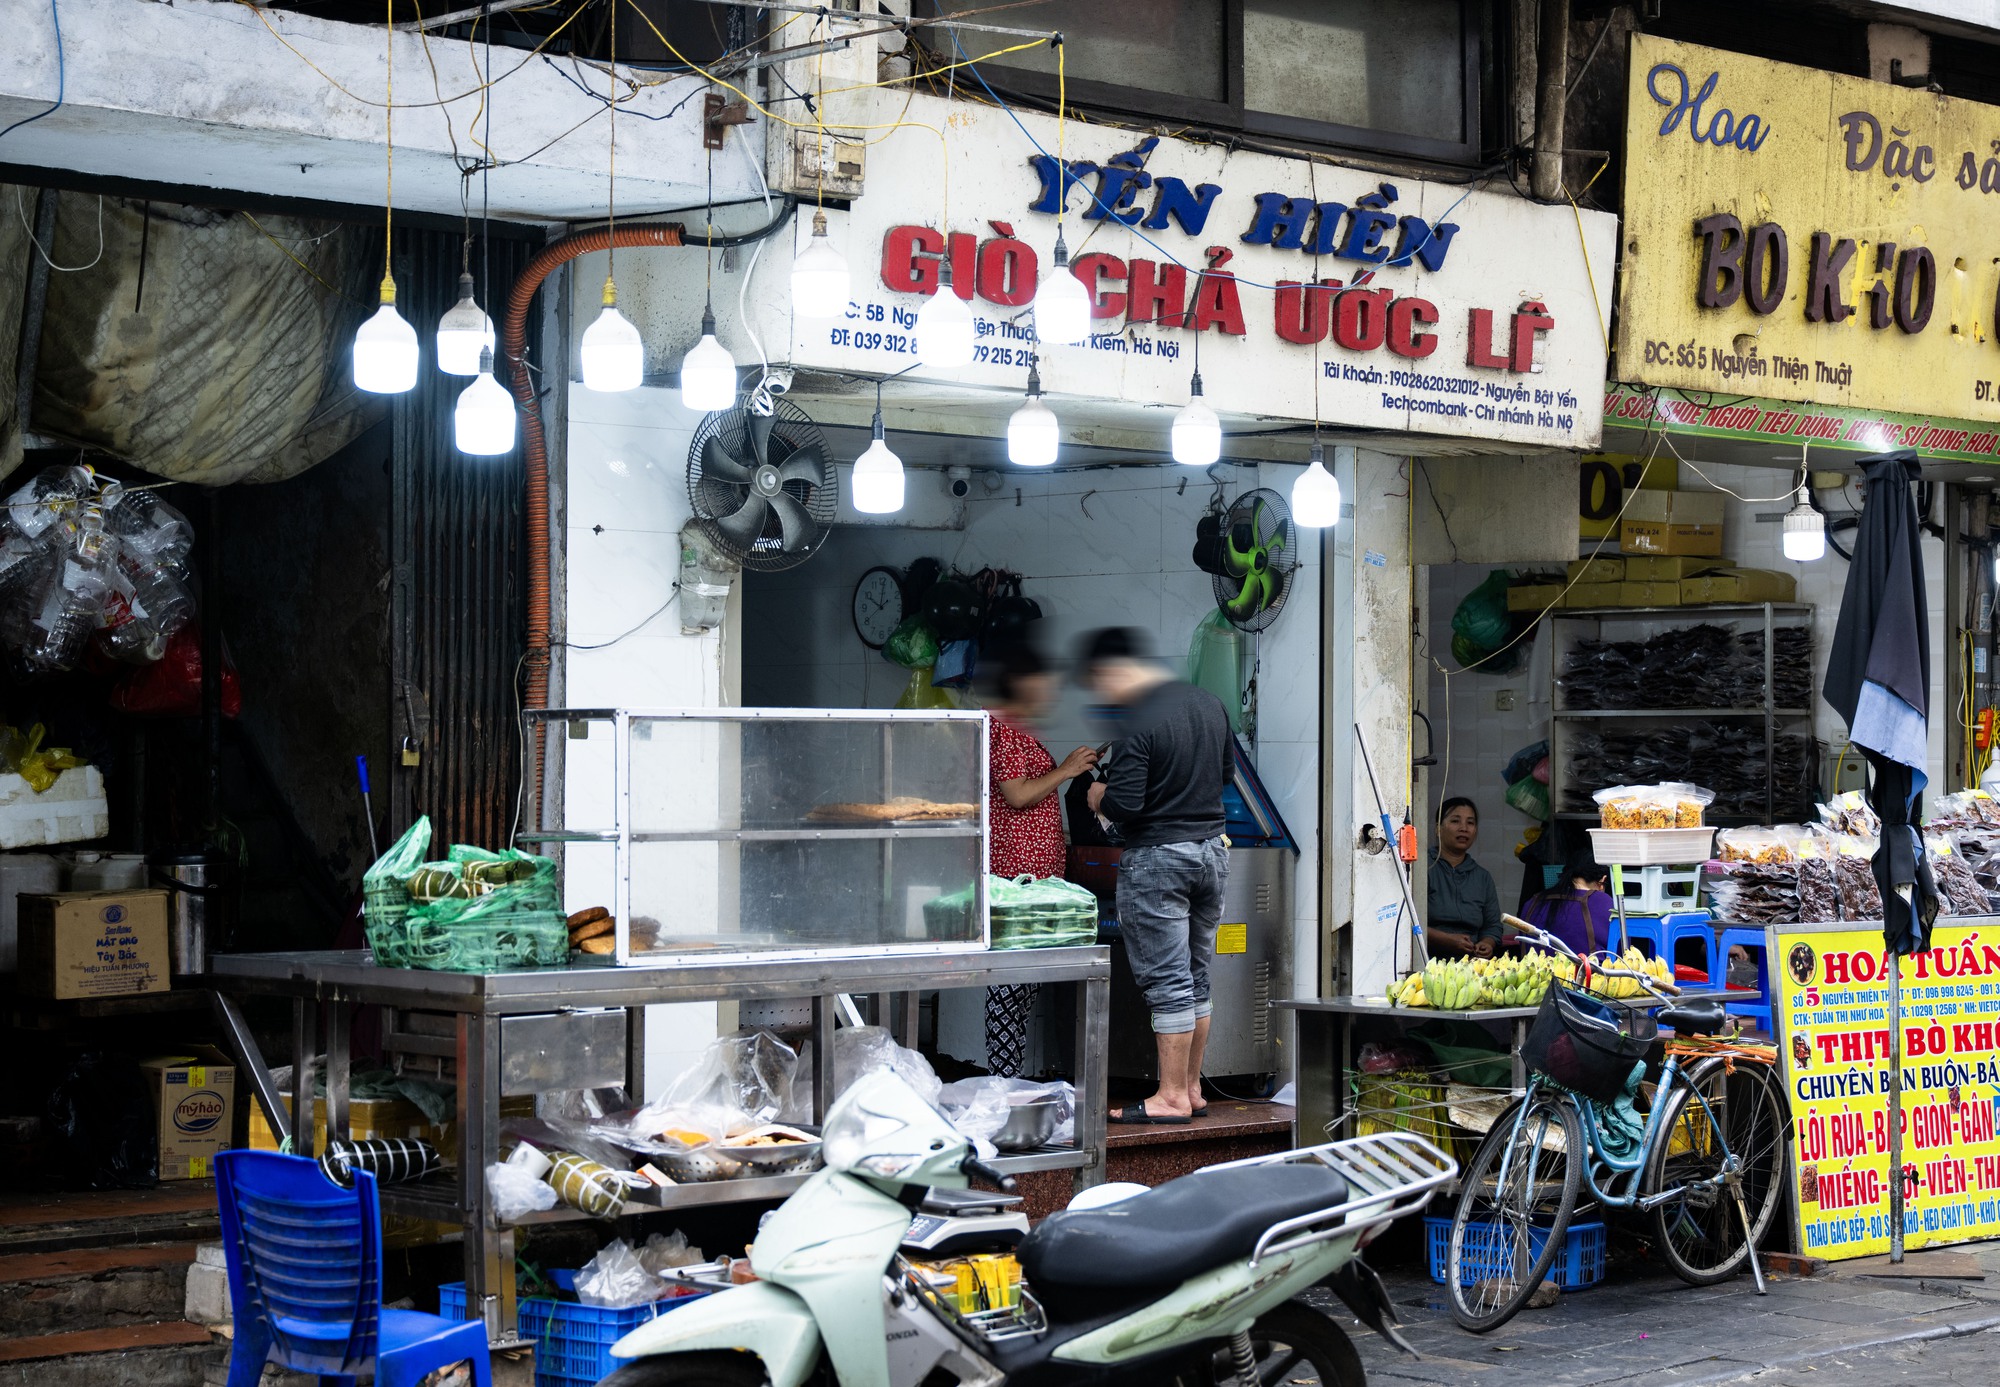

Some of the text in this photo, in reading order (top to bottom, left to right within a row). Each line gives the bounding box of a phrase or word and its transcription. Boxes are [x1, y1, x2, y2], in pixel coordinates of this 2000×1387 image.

[1647, 63, 1771, 152] Hoa
[1838, 110, 1936, 193] Đặc
[1027, 135, 1461, 273] YẾN HIỀN
[880, 219, 1039, 307] GIÒ
[1068, 245, 1248, 336] CHẢ
[1274, 268, 1440, 359] ƯỚC
[830, 327, 851, 347] ĐT:
[854, 331, 882, 351] 039
[883, 333, 907, 353] 312
[990, 346, 1013, 366] 215
[865, 303, 885, 322] 5B
[1133, 336, 1153, 356] Hà
[1156, 339, 1180, 363] Nội
[1323, 361, 1340, 379] Tài
[1534, 388, 1554, 409] Bật
[1556, 388, 1578, 409] Yến
[1644, 338, 1853, 391] ĐC: Số 5 Nguyễn Thiện Thuật
[1498, 406, 1534, 426] nhánh
[1538, 409, 1554, 428] Hà
[1702, 403, 1760, 432] NGƯỜI
[1755, 407, 1796, 435] TIÊU
[1793, 410, 1845, 442] DÙNG,
[1899, 420, 1933, 448] SỬ
[1920, 427, 1968, 454] DỤNG
[1962, 429, 2000, 455] HÓA
[97, 947, 137, 963] Tây Bắc
[1792, 990, 1804, 1008] SỐ
[1806, 986, 1820, 1007] 5
[1822, 988, 1854, 1006] NGUYỄN
[1856, 988, 1879, 1006] THIỆN
[1911, 987, 1924, 1000] ĐT:
[1925, 986, 1939, 999] 096
[1940, 985, 1955, 998] 998
[1956, 984, 1974, 997] 6245
[1980, 983, 1993, 995] 091
[1793, 1012, 1811, 1026] CTK:
[1812, 1007, 1834, 1024] TUẤN
[1835, 1009, 1848, 1025] THỊ
[1850, 1007, 1868, 1022] NHƯ
[1868, 1007, 1885, 1021] HOA
[1910, 1004, 1933, 1017] 10298
[1935, 1003, 1958, 1016] 12568
[1964, 1001, 1977, 1014] NH:
[1816, 1018, 2000, 1068] THỊT BÒ KH
[1797, 1066, 1875, 1101] CHUYÊN
[1879, 1067, 1917, 1093] BN
[1798, 1108, 1827, 1162] LÕI
[1805, 1218, 1829, 1248] TRÂU
[1830, 1213, 1848, 1245] GÁC
[1848, 1209, 1866, 1243] BẾP
[1941, 1200, 1961, 1229] CHÁY
[1962, 1194, 1976, 1227] TỎI
[886, 1329, 919, 1343] ONDA
